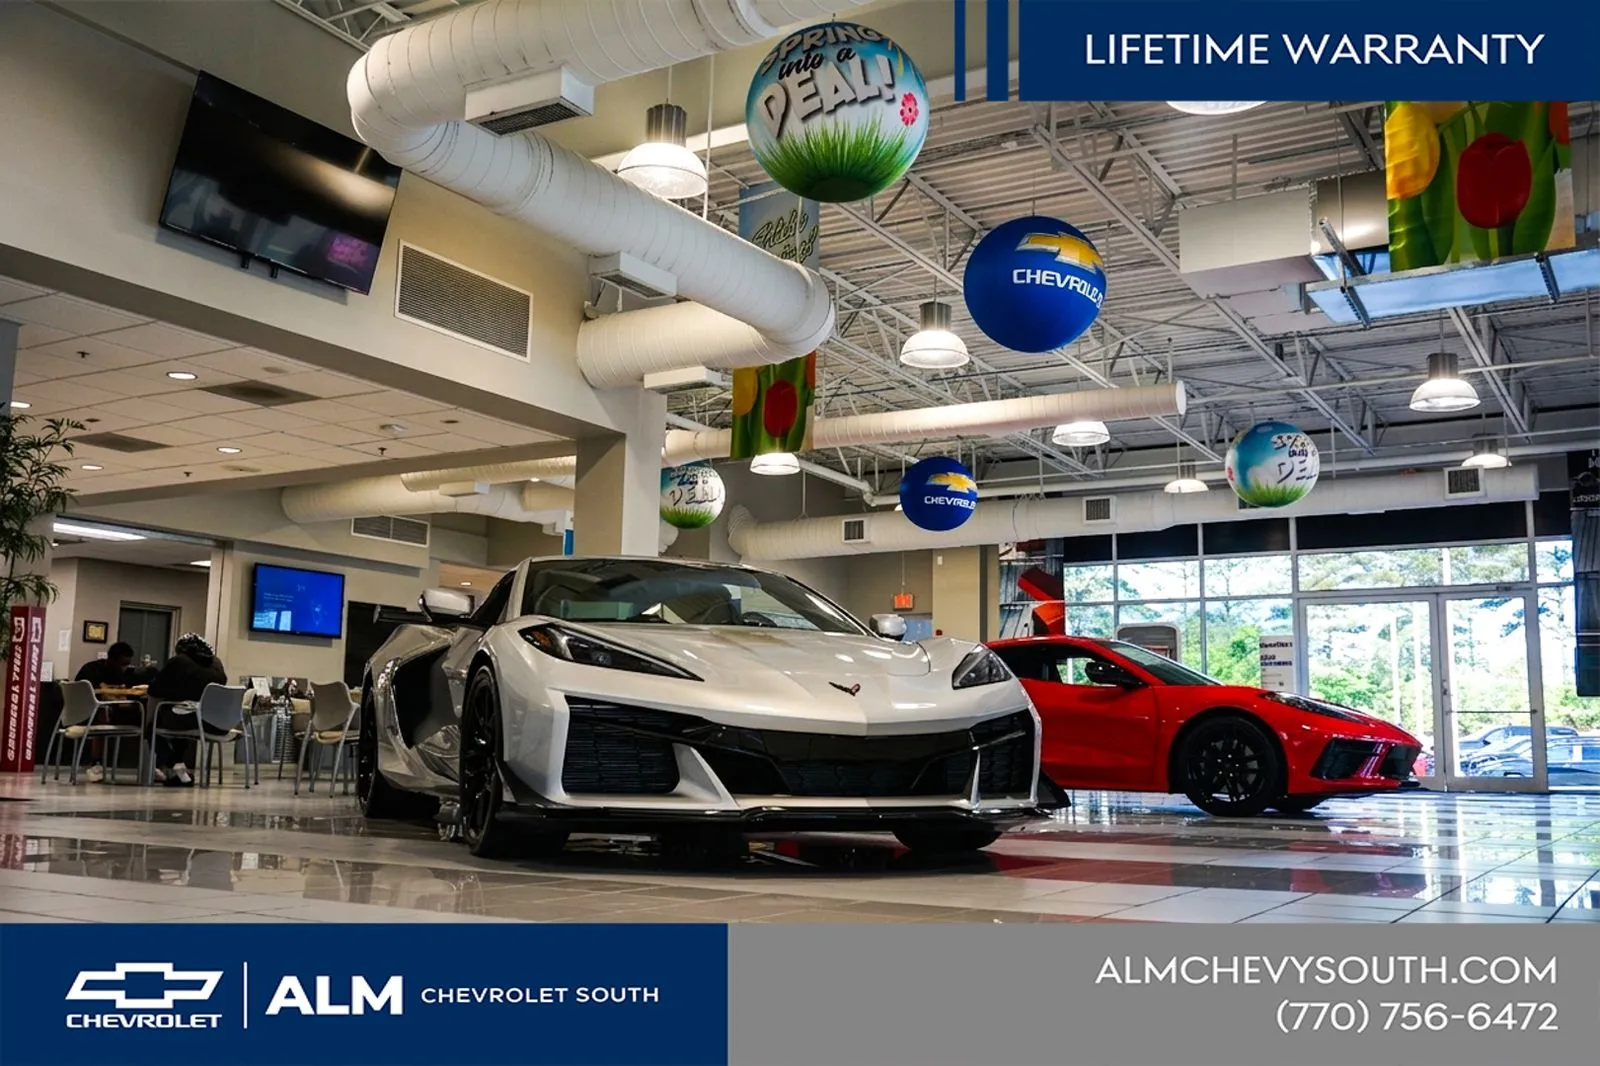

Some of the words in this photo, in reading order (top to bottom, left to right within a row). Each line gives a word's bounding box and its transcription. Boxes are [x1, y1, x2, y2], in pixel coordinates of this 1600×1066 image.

[778, 51, 824, 80] into
[836, 46, 857, 63] a
[757, 53, 898, 139] DEAL!
